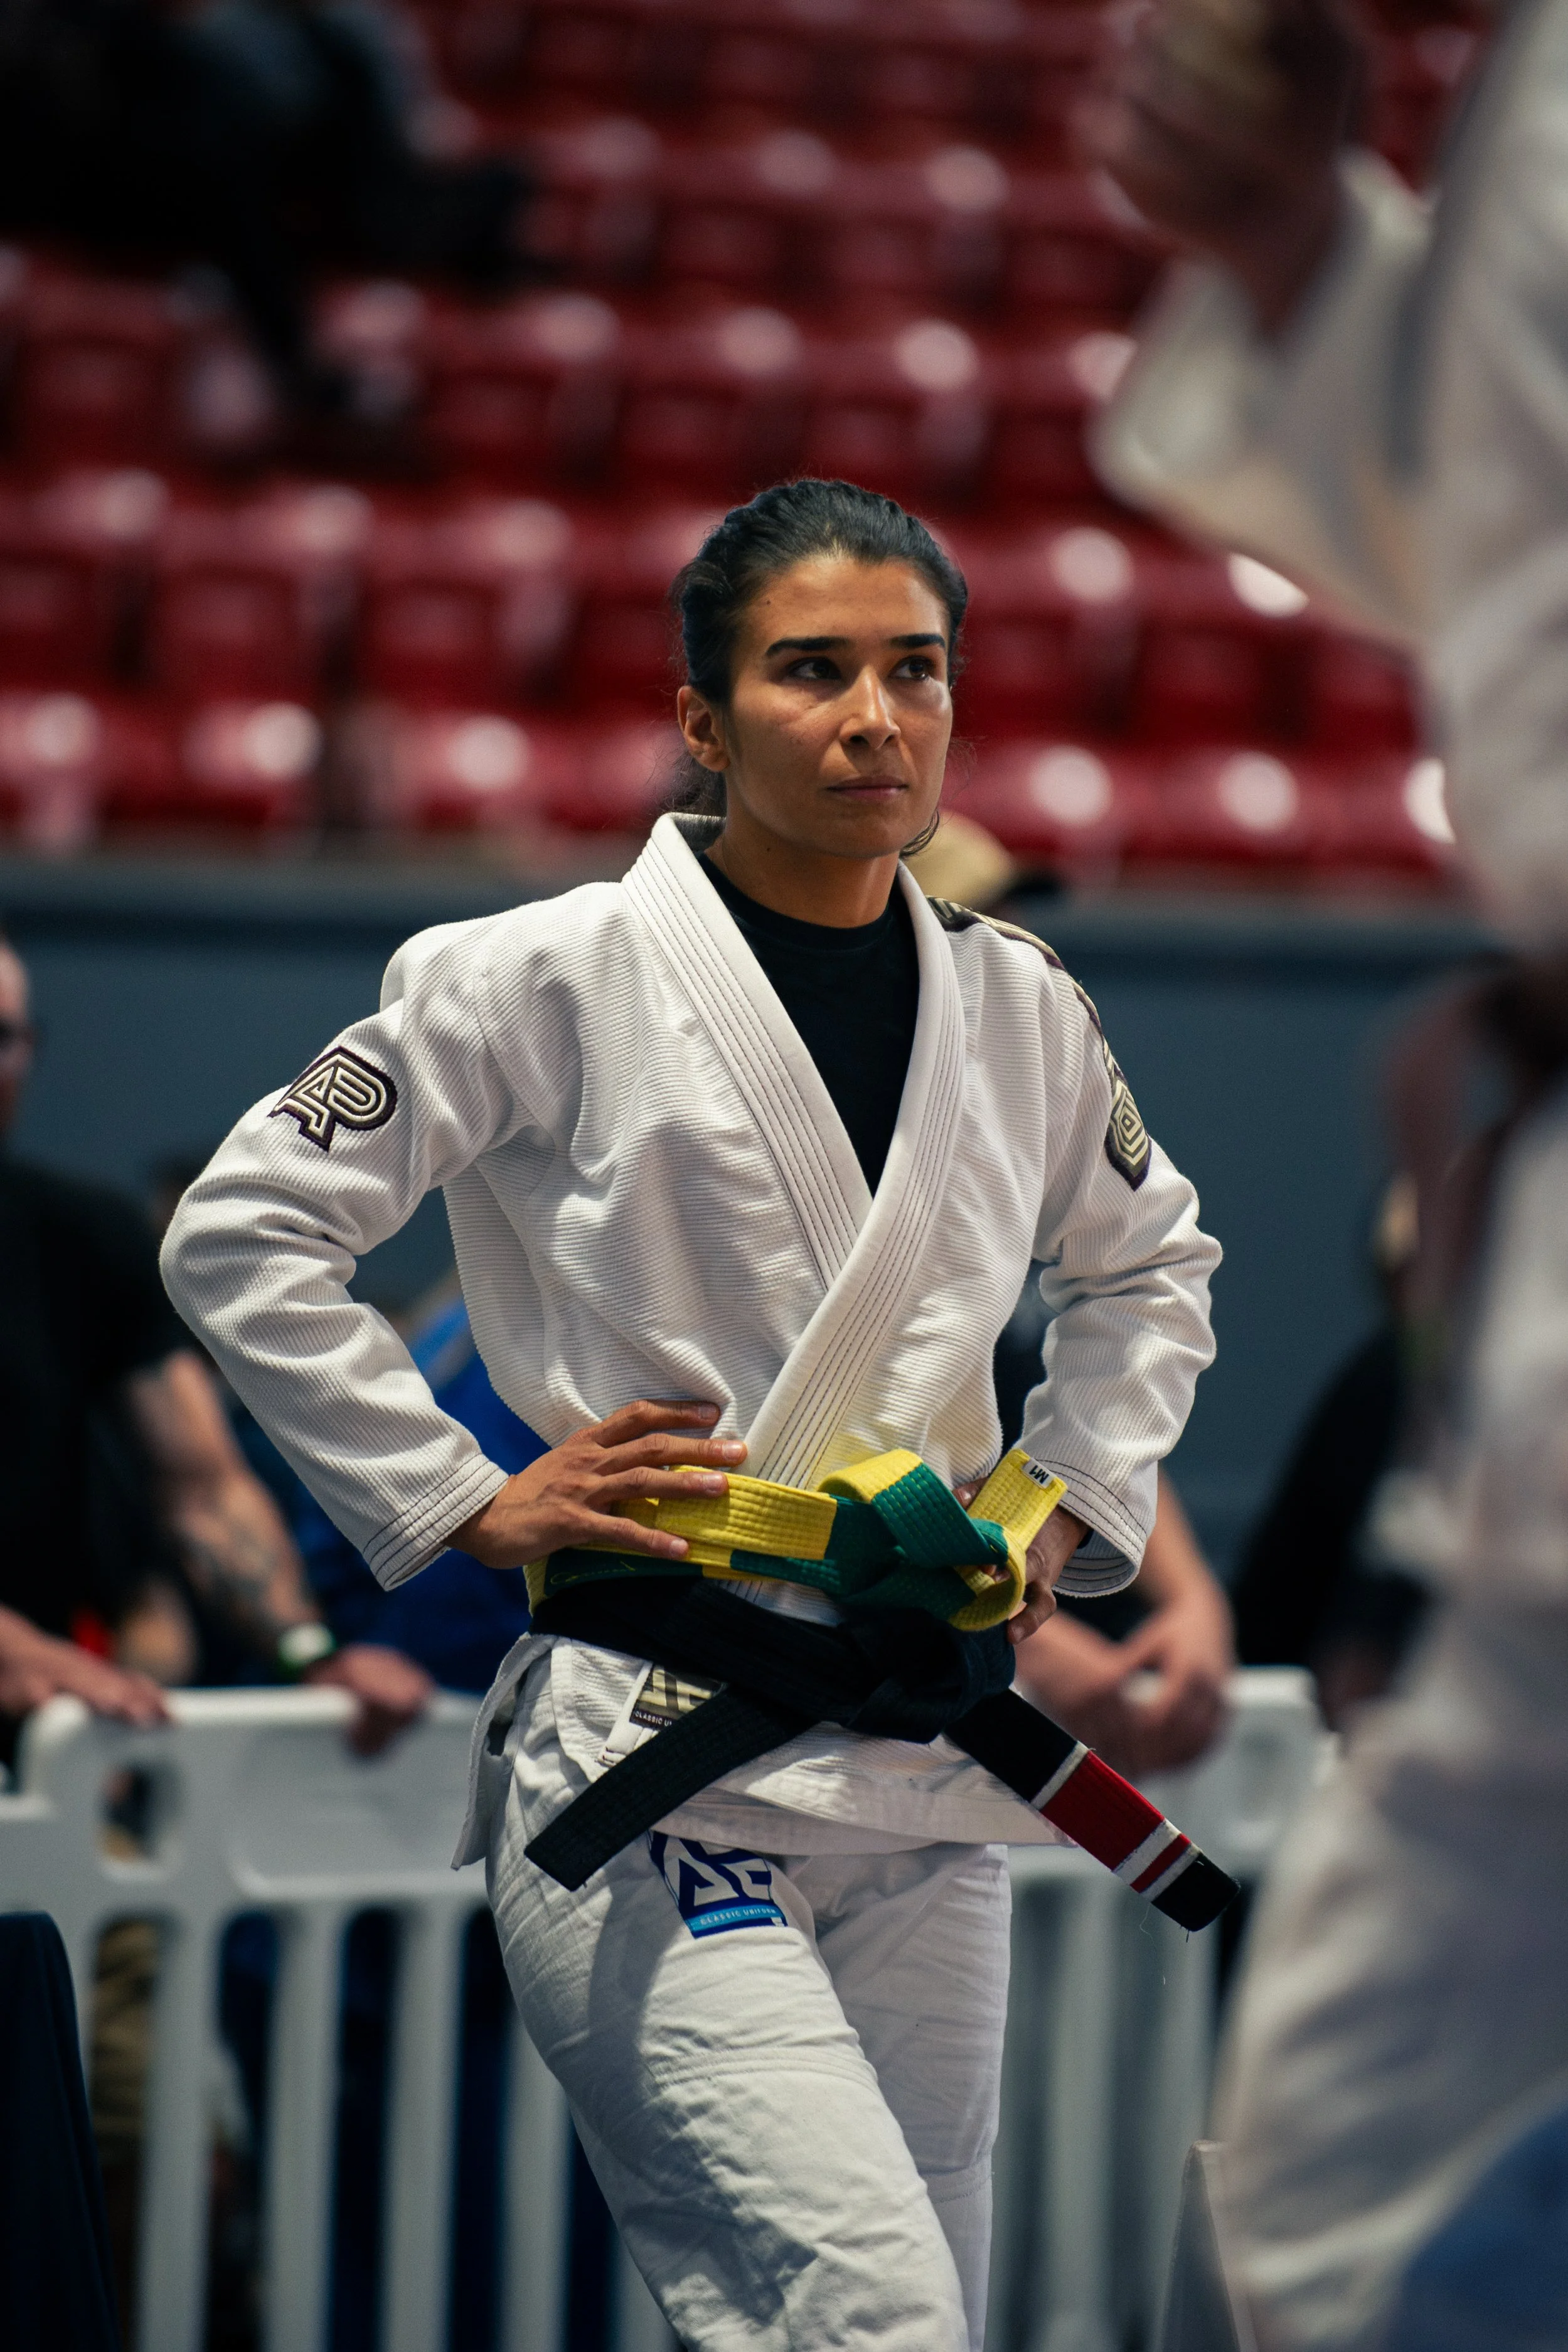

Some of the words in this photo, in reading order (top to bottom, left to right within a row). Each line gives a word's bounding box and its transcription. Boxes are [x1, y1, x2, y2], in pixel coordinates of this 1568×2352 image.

[1028, 1465, 1050, 1484] M1
[635, 1711, 663, 1724] CLASSIC
[700, 1910, 741, 1925] CLASSIC
